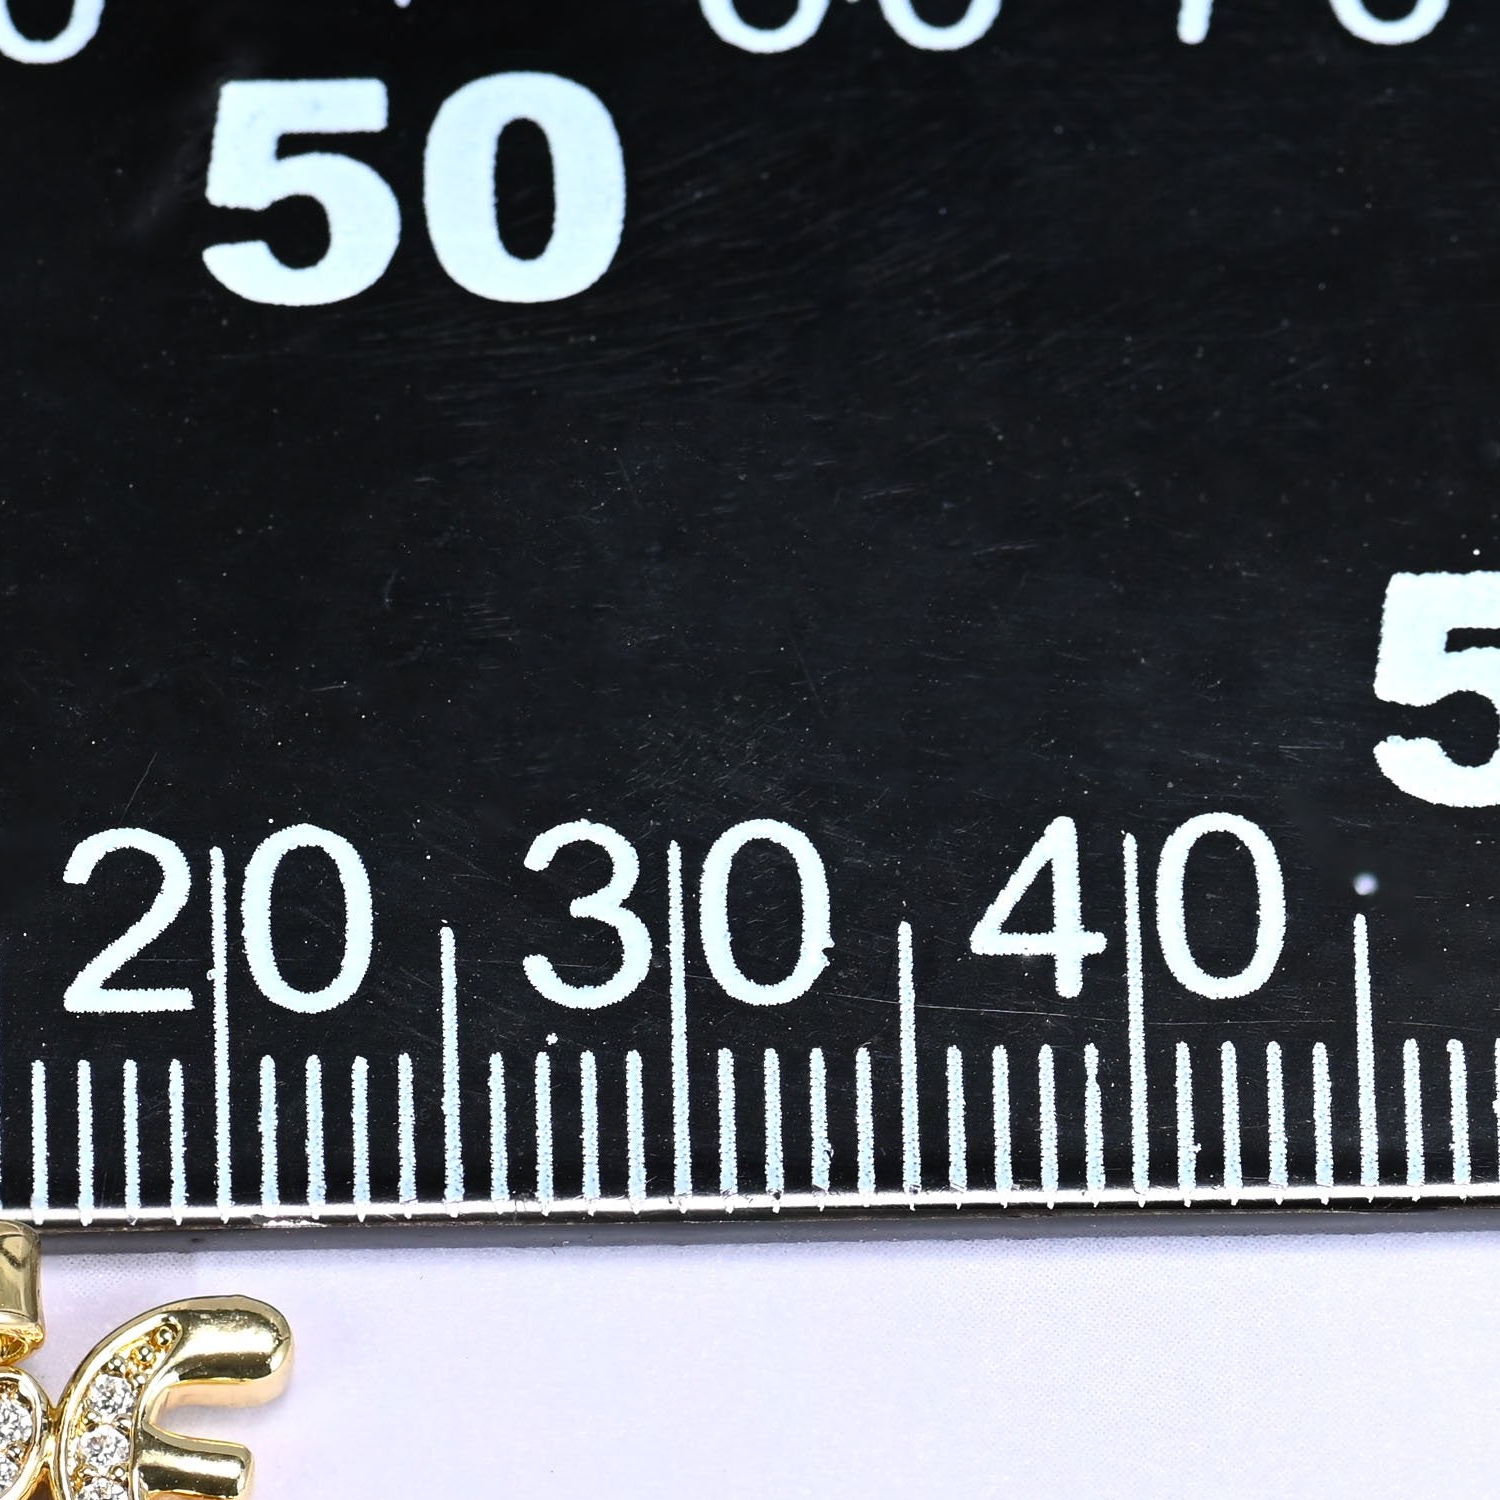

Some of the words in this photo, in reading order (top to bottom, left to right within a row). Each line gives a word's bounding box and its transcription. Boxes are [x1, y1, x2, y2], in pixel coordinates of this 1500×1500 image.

[203, 72, 626, 306] 50
[63, 823, 373, 1014] 20
[523, 818, 835, 1010] 30
[969, 812, 1286, 1000] 40
